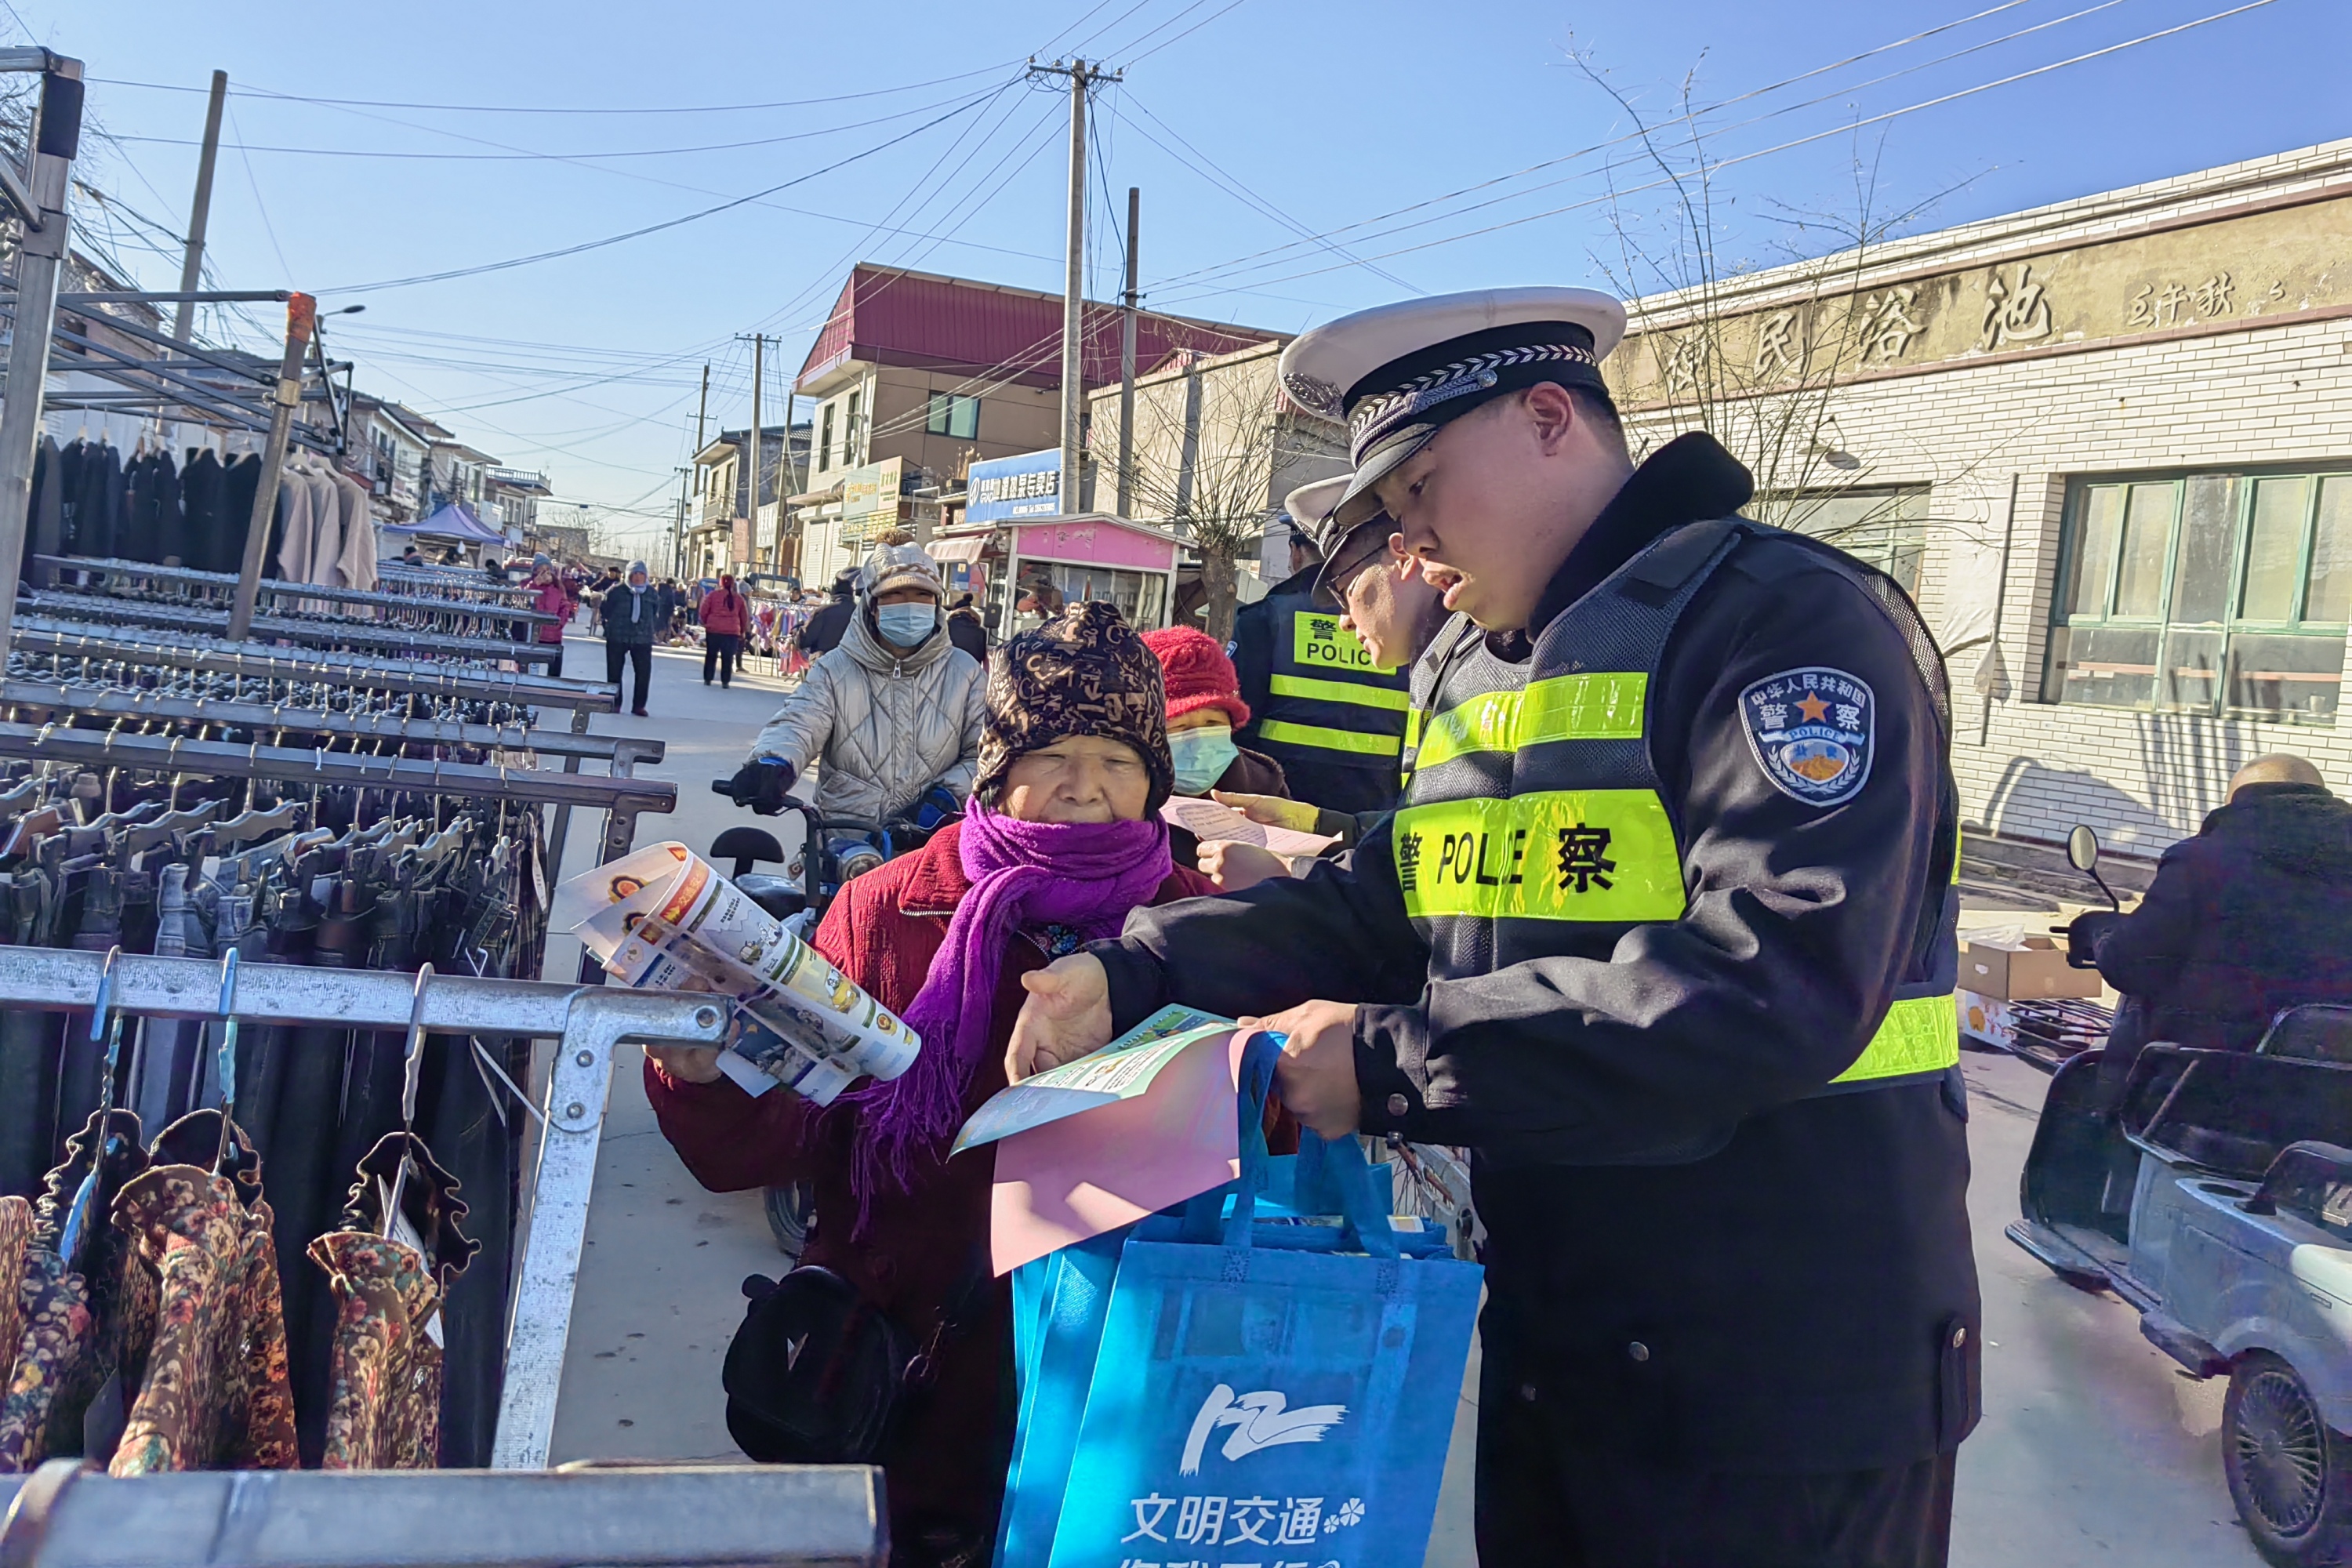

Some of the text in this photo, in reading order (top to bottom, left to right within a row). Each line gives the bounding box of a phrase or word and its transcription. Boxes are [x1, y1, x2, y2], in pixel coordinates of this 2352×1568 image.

[1310, 619, 1337, 641] 警
[1307, 643, 1370, 666] POLIC
[1751, 673, 1866, 708] 中华人民共和国
[1759, 703, 1860, 731] 警 察
[1788, 726, 1840, 741] POLICE
[1399, 831, 1423, 892] 警
[1557, 822, 1617, 893] 察
[1120, 1492, 1324, 1546] 文明交通
